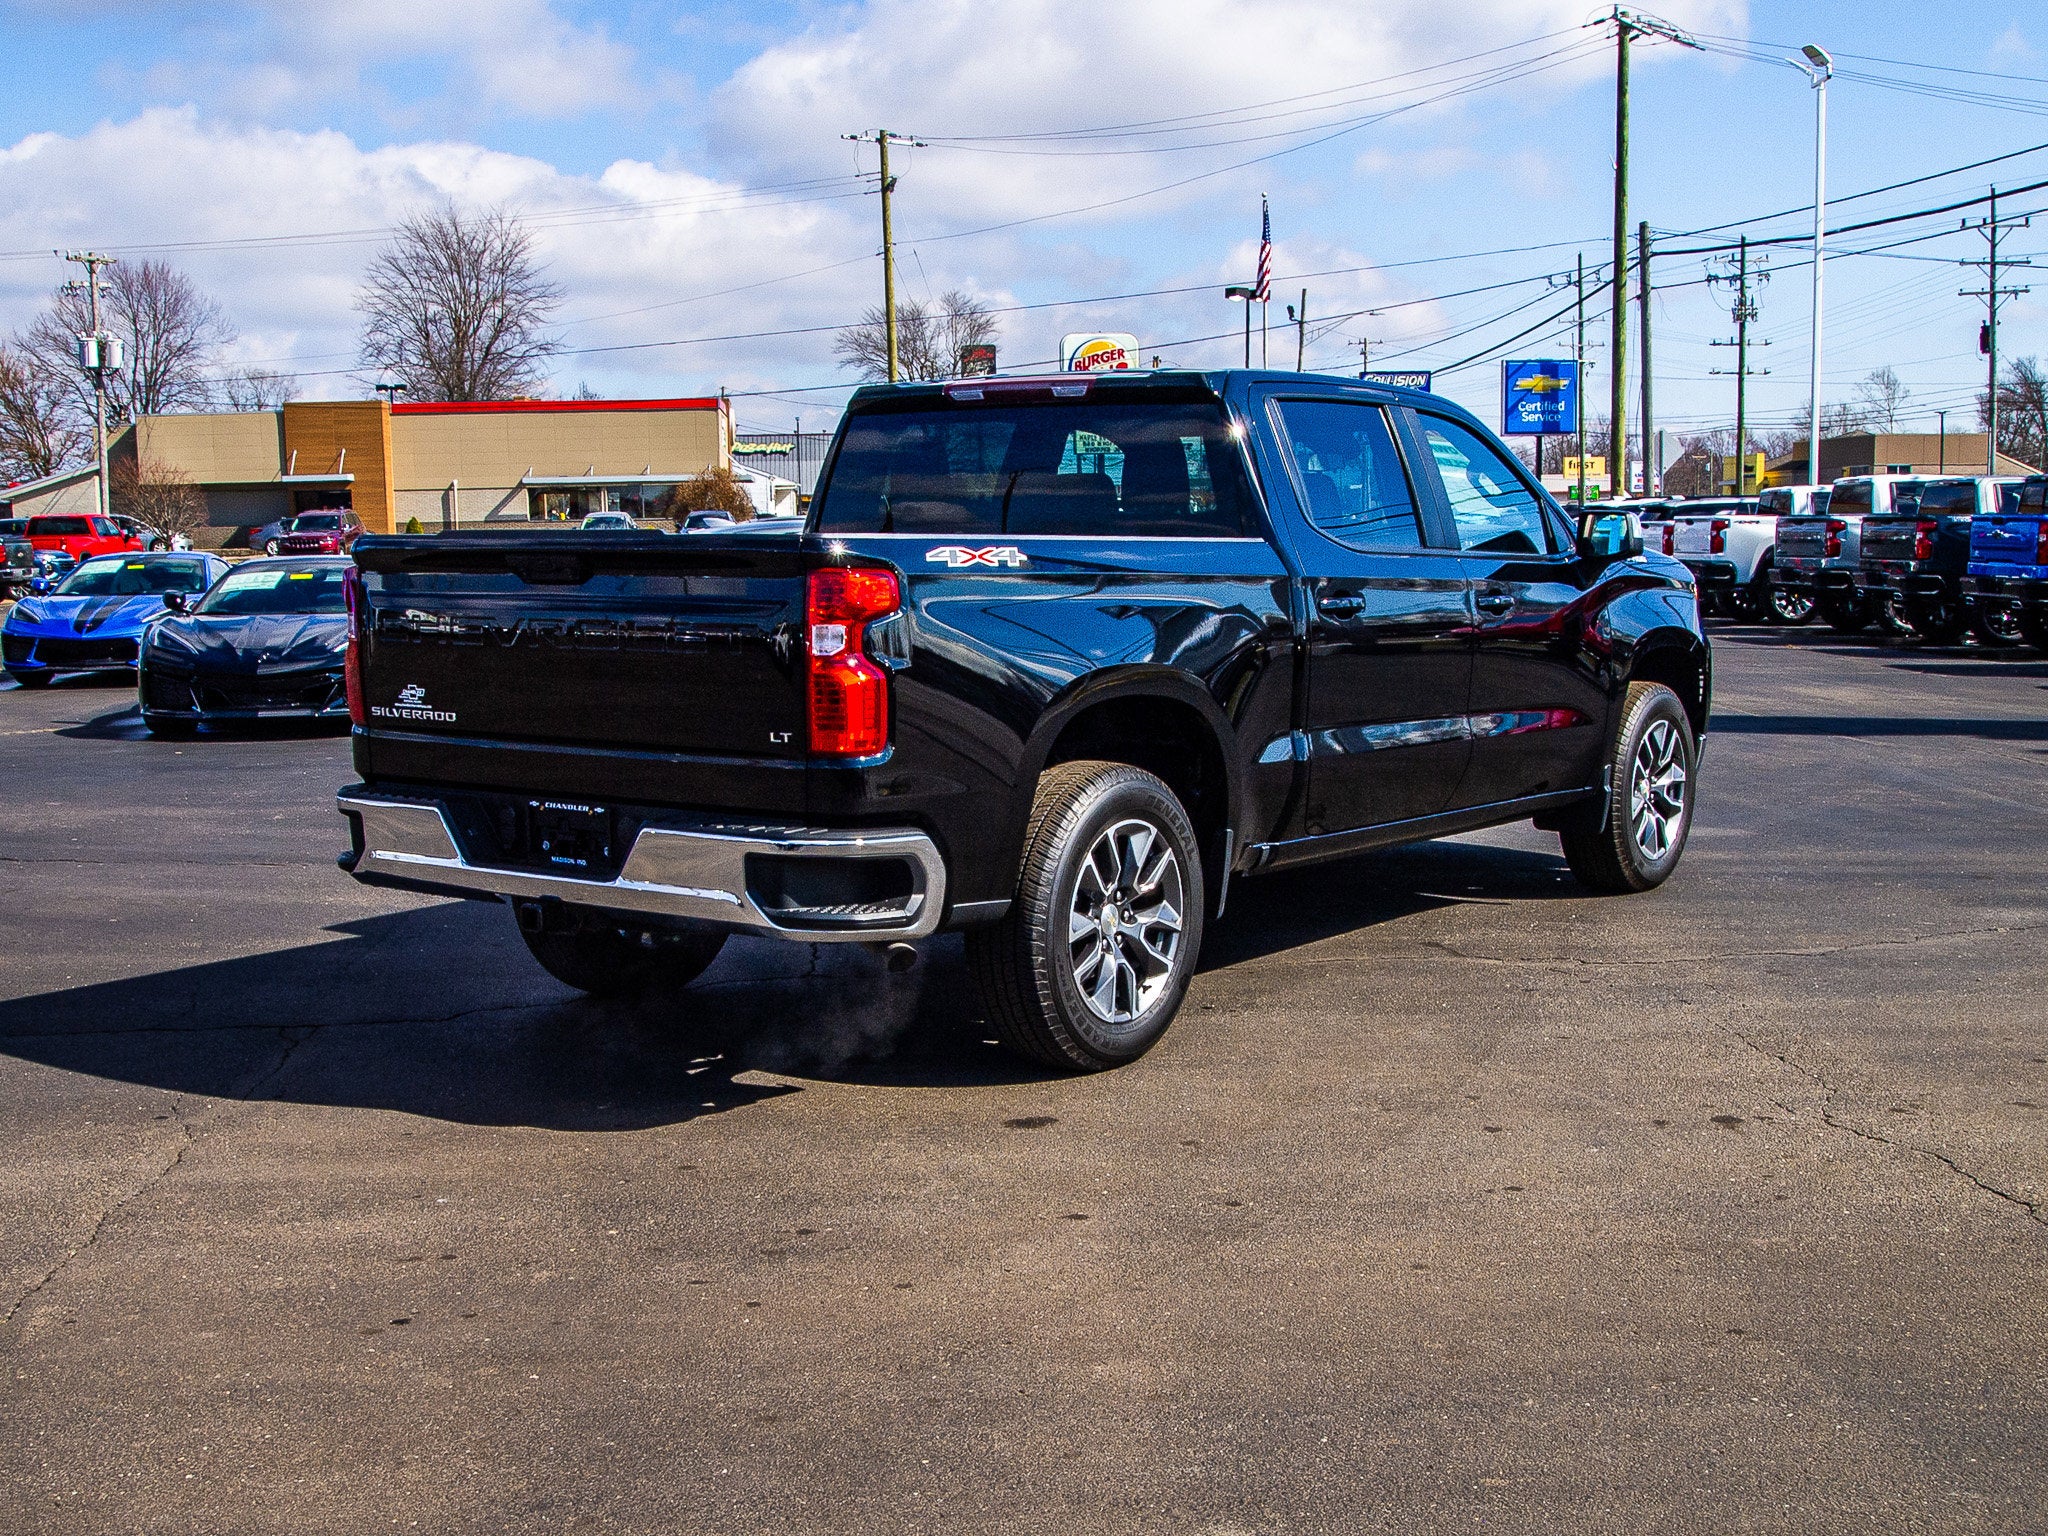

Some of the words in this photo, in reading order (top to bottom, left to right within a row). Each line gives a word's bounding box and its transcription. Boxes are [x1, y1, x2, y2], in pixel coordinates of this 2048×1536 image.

[1074, 348, 1126, 371] BURGER
[1518, 400, 1565, 411] Certified
[1521, 412, 1561, 422] Service
[379, 616, 756, 655] CHEVROLET
[371, 706, 457, 721] SILVERADO
[770, 732, 792, 743] LT
[544, 802, 590, 812] CHANDLER
